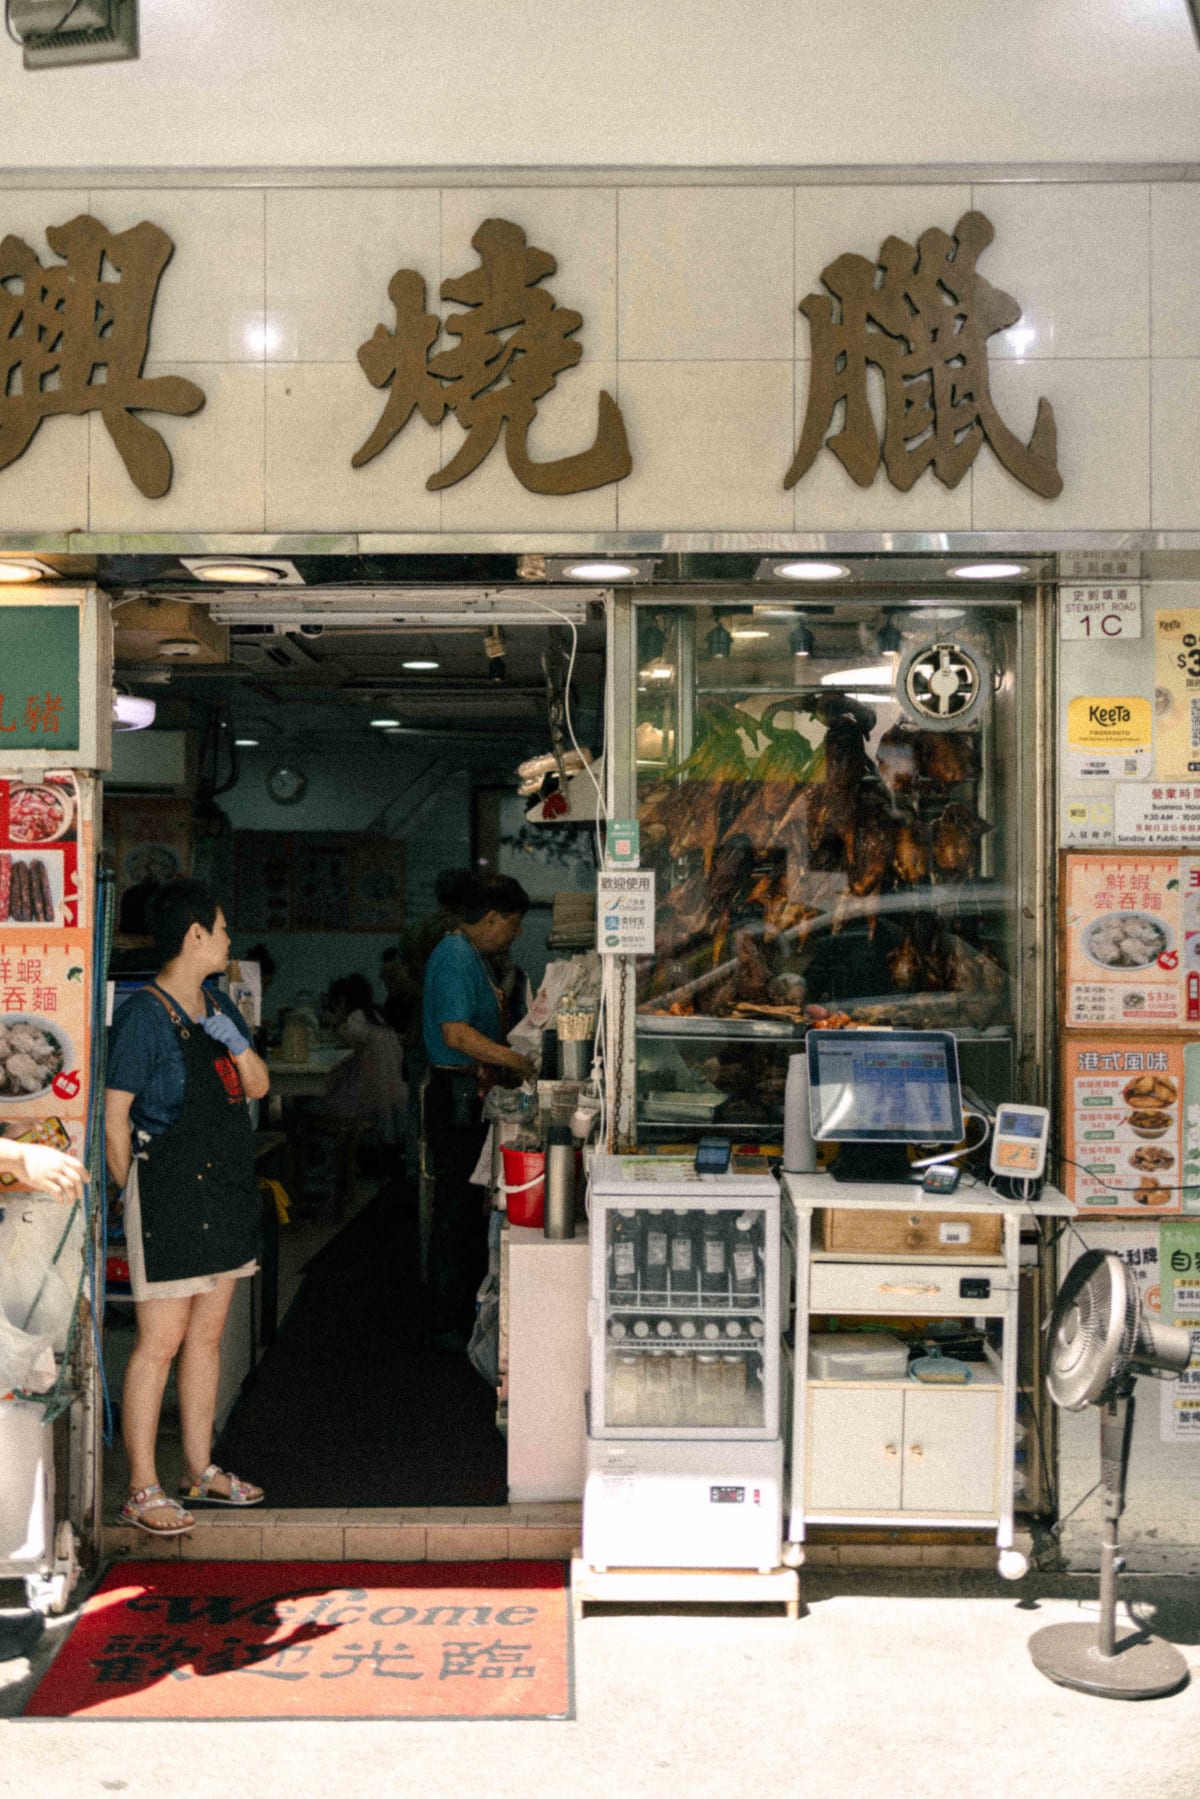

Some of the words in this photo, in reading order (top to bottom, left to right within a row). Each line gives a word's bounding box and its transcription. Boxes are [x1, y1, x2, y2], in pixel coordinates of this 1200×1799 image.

[1065, 602, 1105, 613] STEWART
[1112, 602, 1136, 611] ROAD
[601, 878, 650, 890] 歡迎使用
[1078, 1052, 1168, 1071] 港式風味
[126, 1586, 538, 1628] Welcome
[90, 1633, 537, 1684] 歡迎光臨
